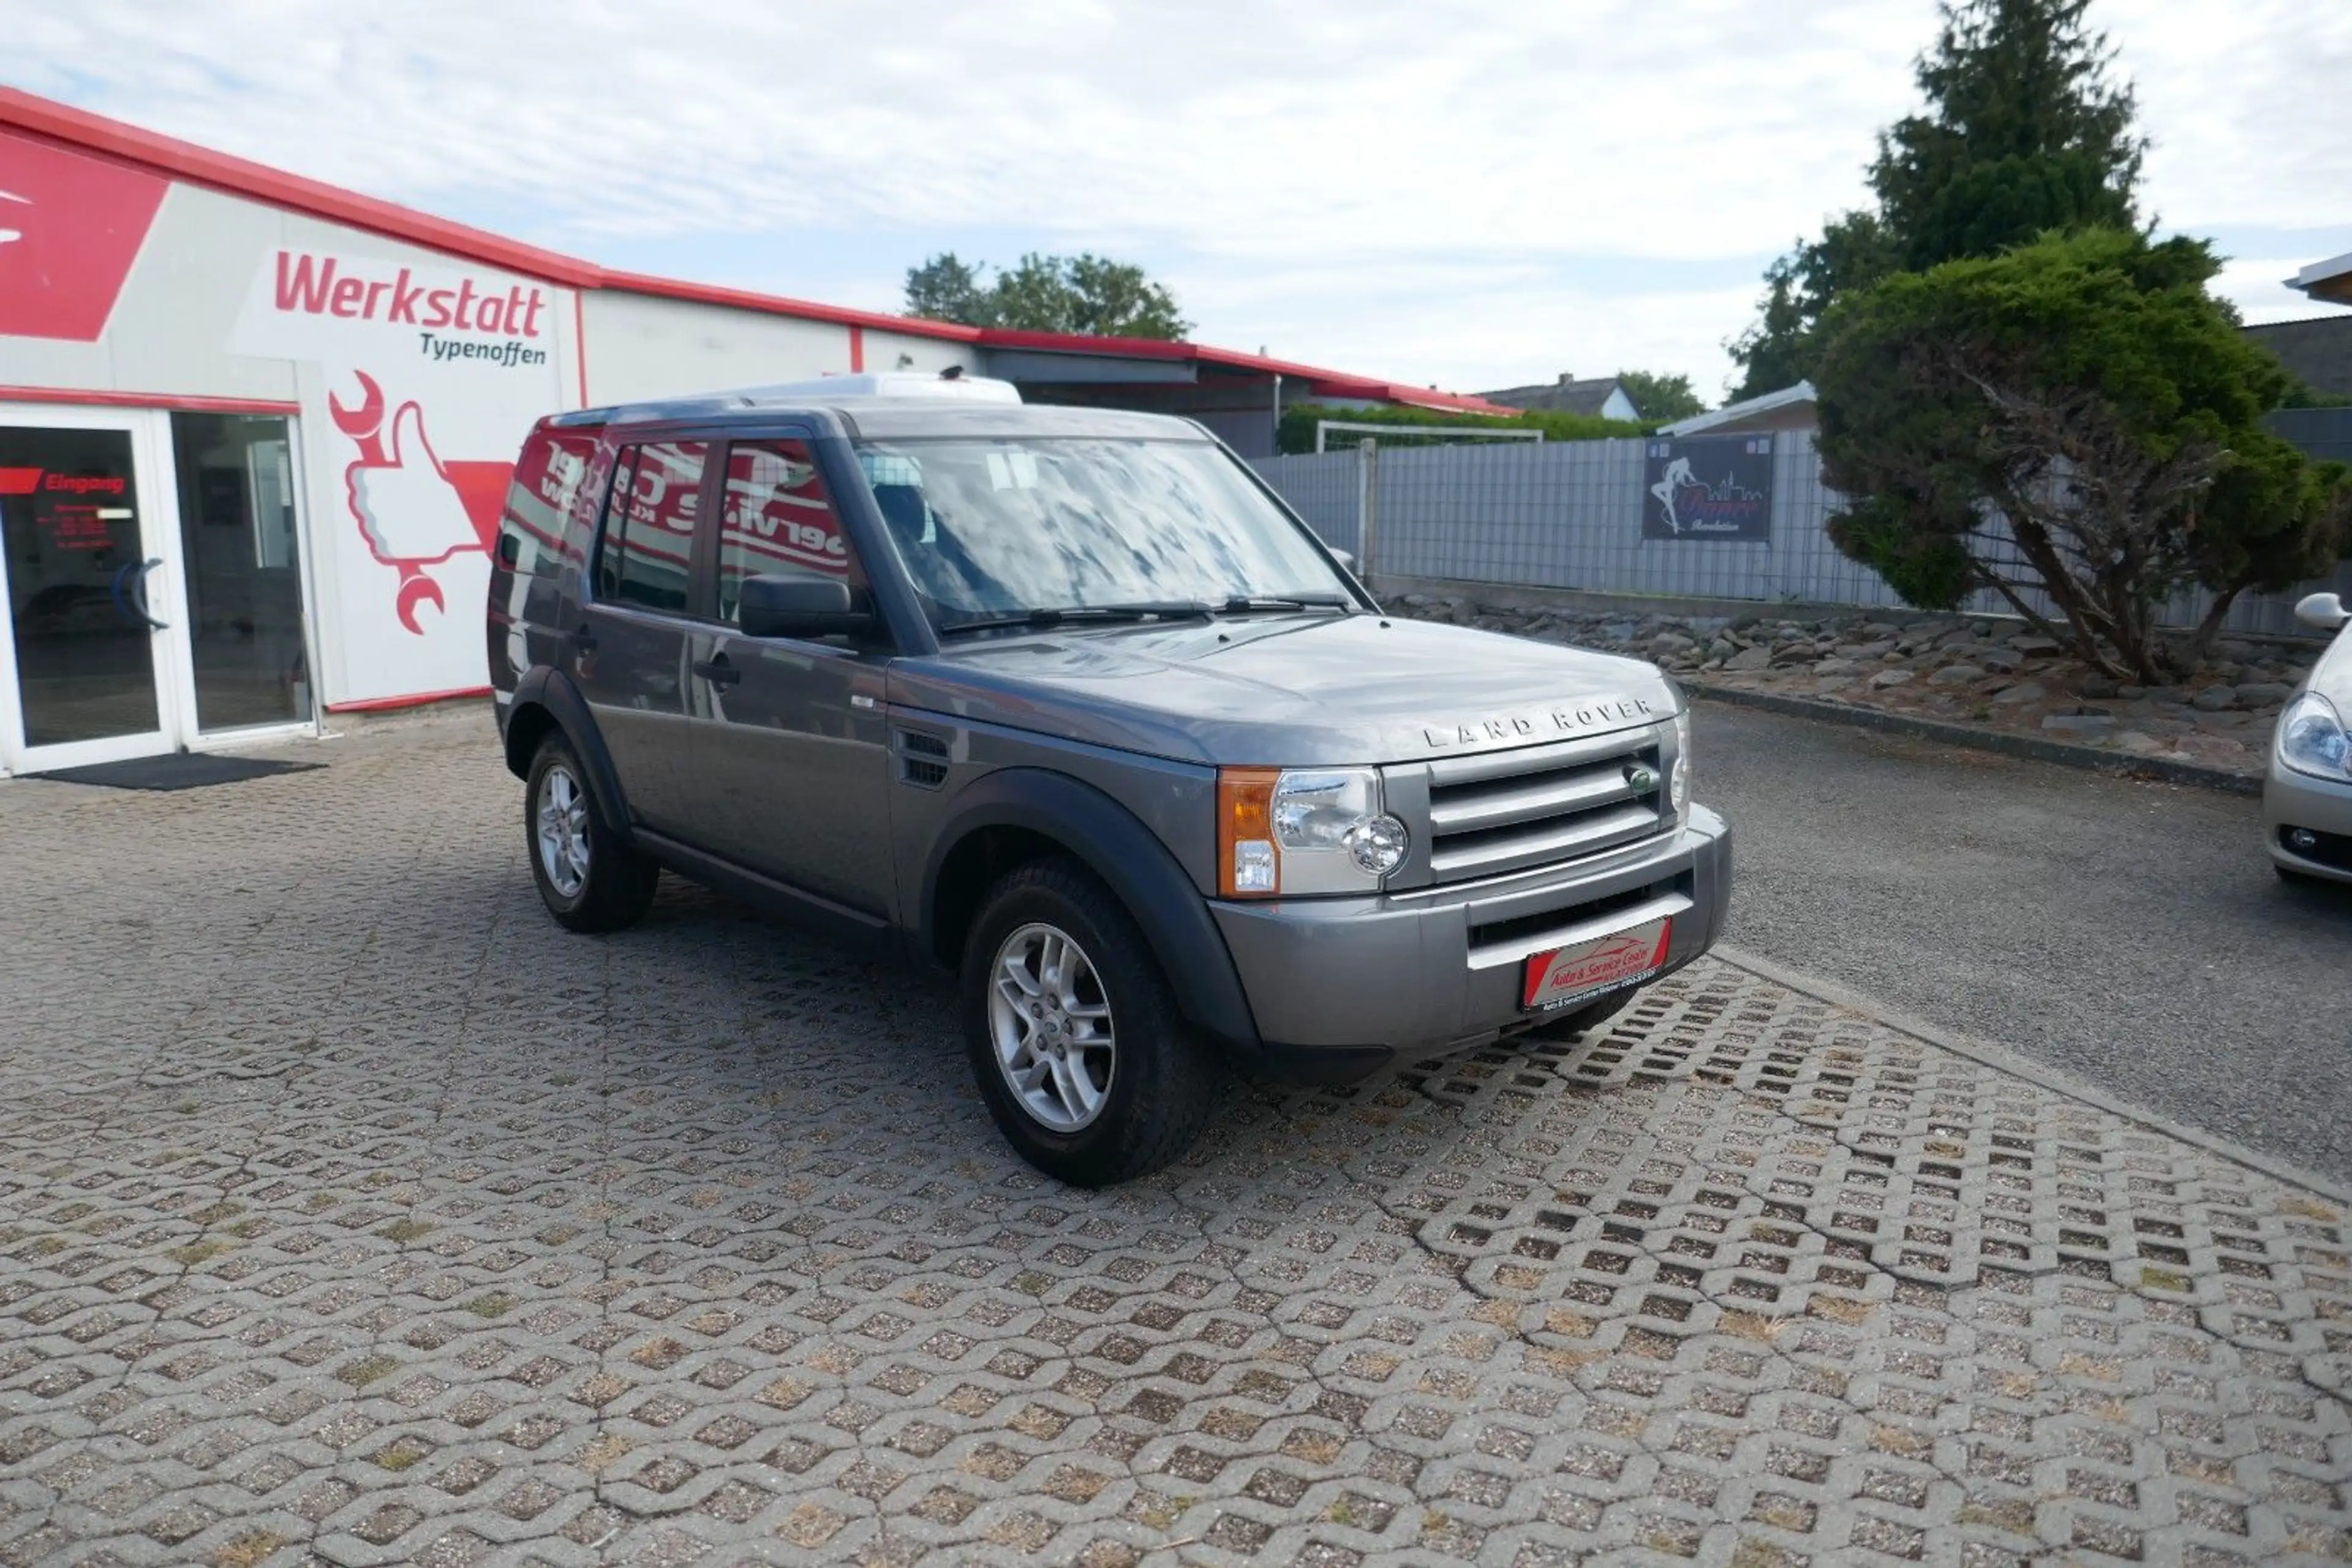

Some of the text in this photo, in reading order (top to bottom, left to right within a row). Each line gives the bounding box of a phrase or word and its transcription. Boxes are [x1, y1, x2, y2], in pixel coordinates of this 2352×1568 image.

[275, 251, 546, 337] Werkstatt
[420, 333, 546, 367] Typenoffen
[45, 473, 125, 494] Eingang
[1423, 698, 1653, 747] LAND ROVER
[1587, 958, 1621, 976] Service
